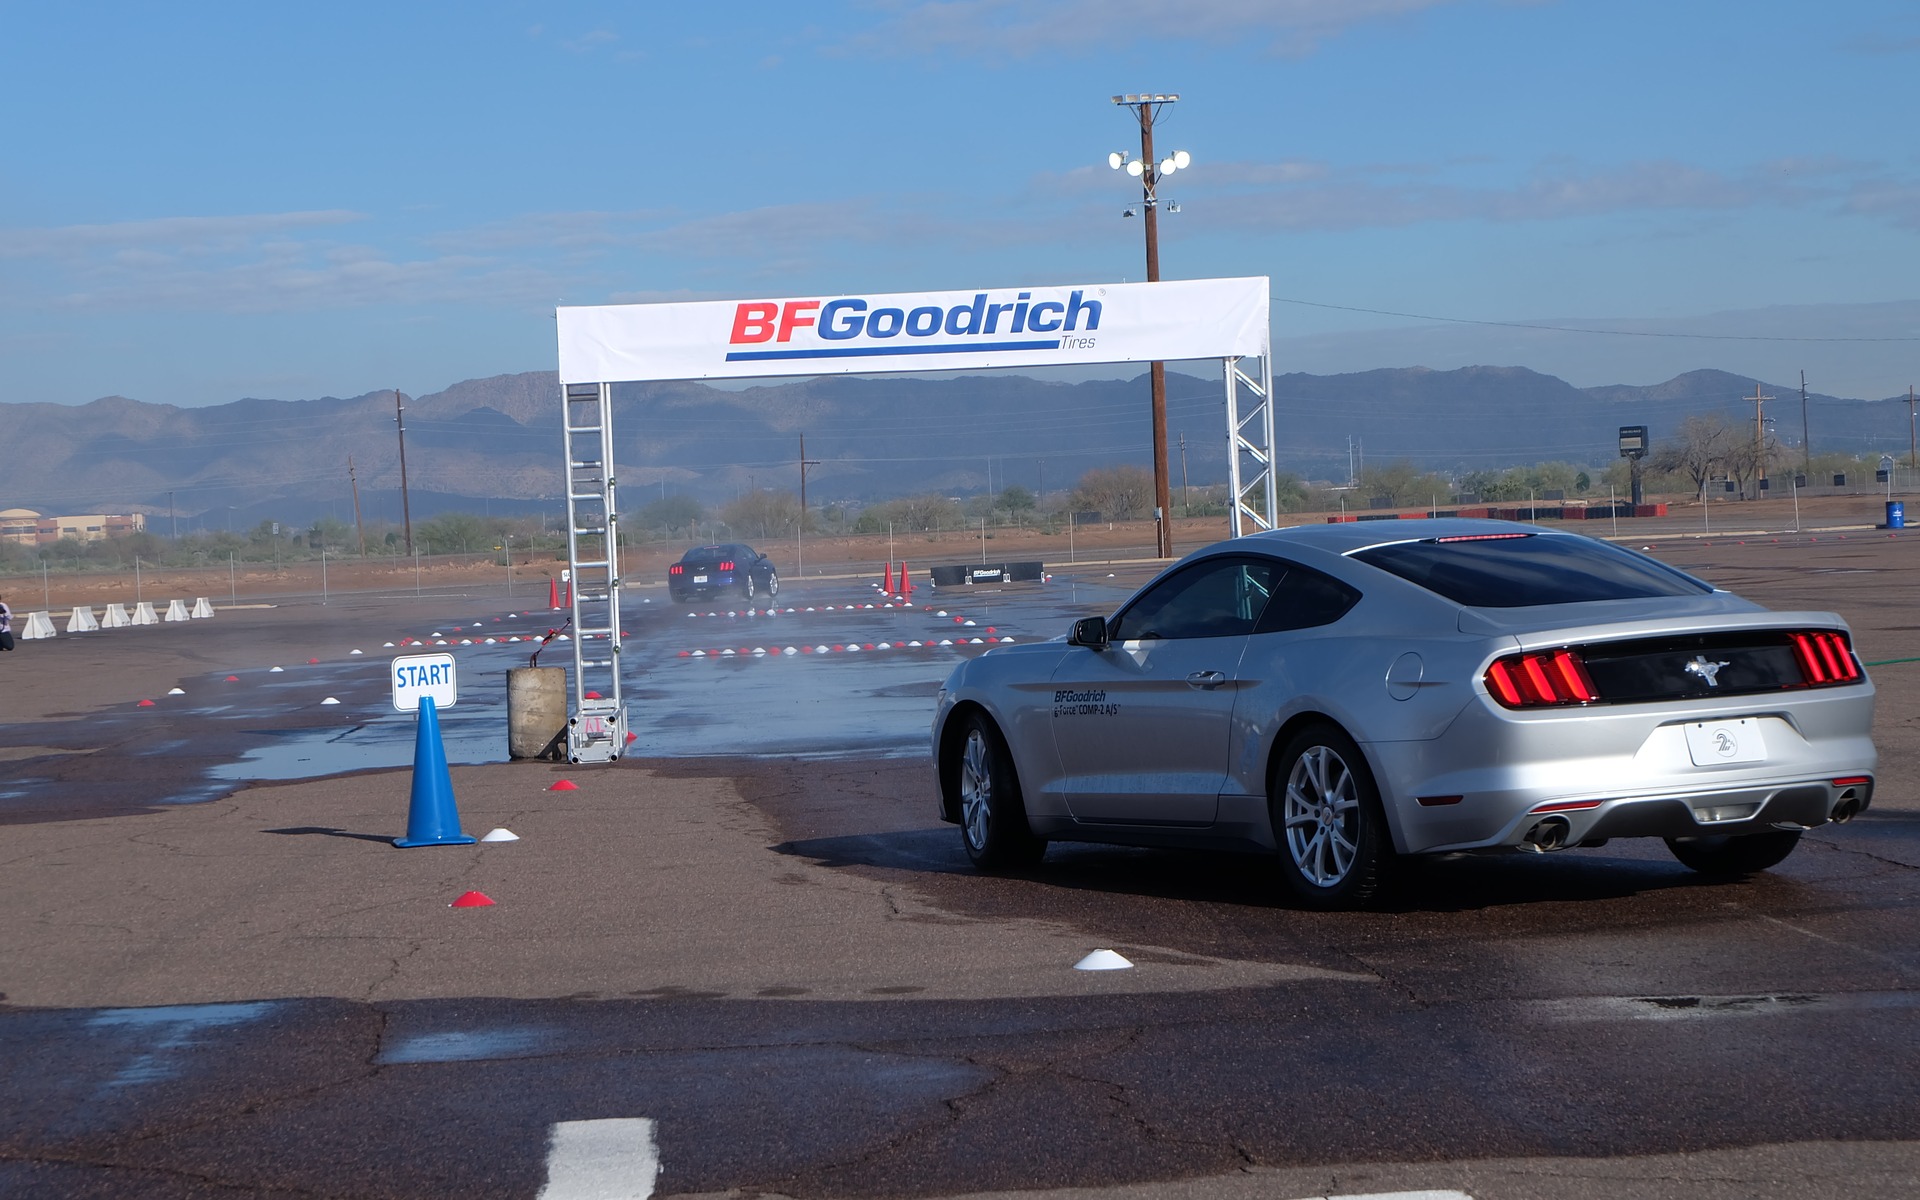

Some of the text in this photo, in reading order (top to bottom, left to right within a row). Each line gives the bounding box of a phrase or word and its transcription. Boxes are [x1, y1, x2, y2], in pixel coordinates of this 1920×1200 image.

[729, 290, 1103, 344] BFGoodrich
[1062, 335, 1096, 350] Tires
[397, 663, 451, 688] START
[1054, 690, 1106, 702] BFGoodrich
[1079, 704, 1104, 715] COMP-2
